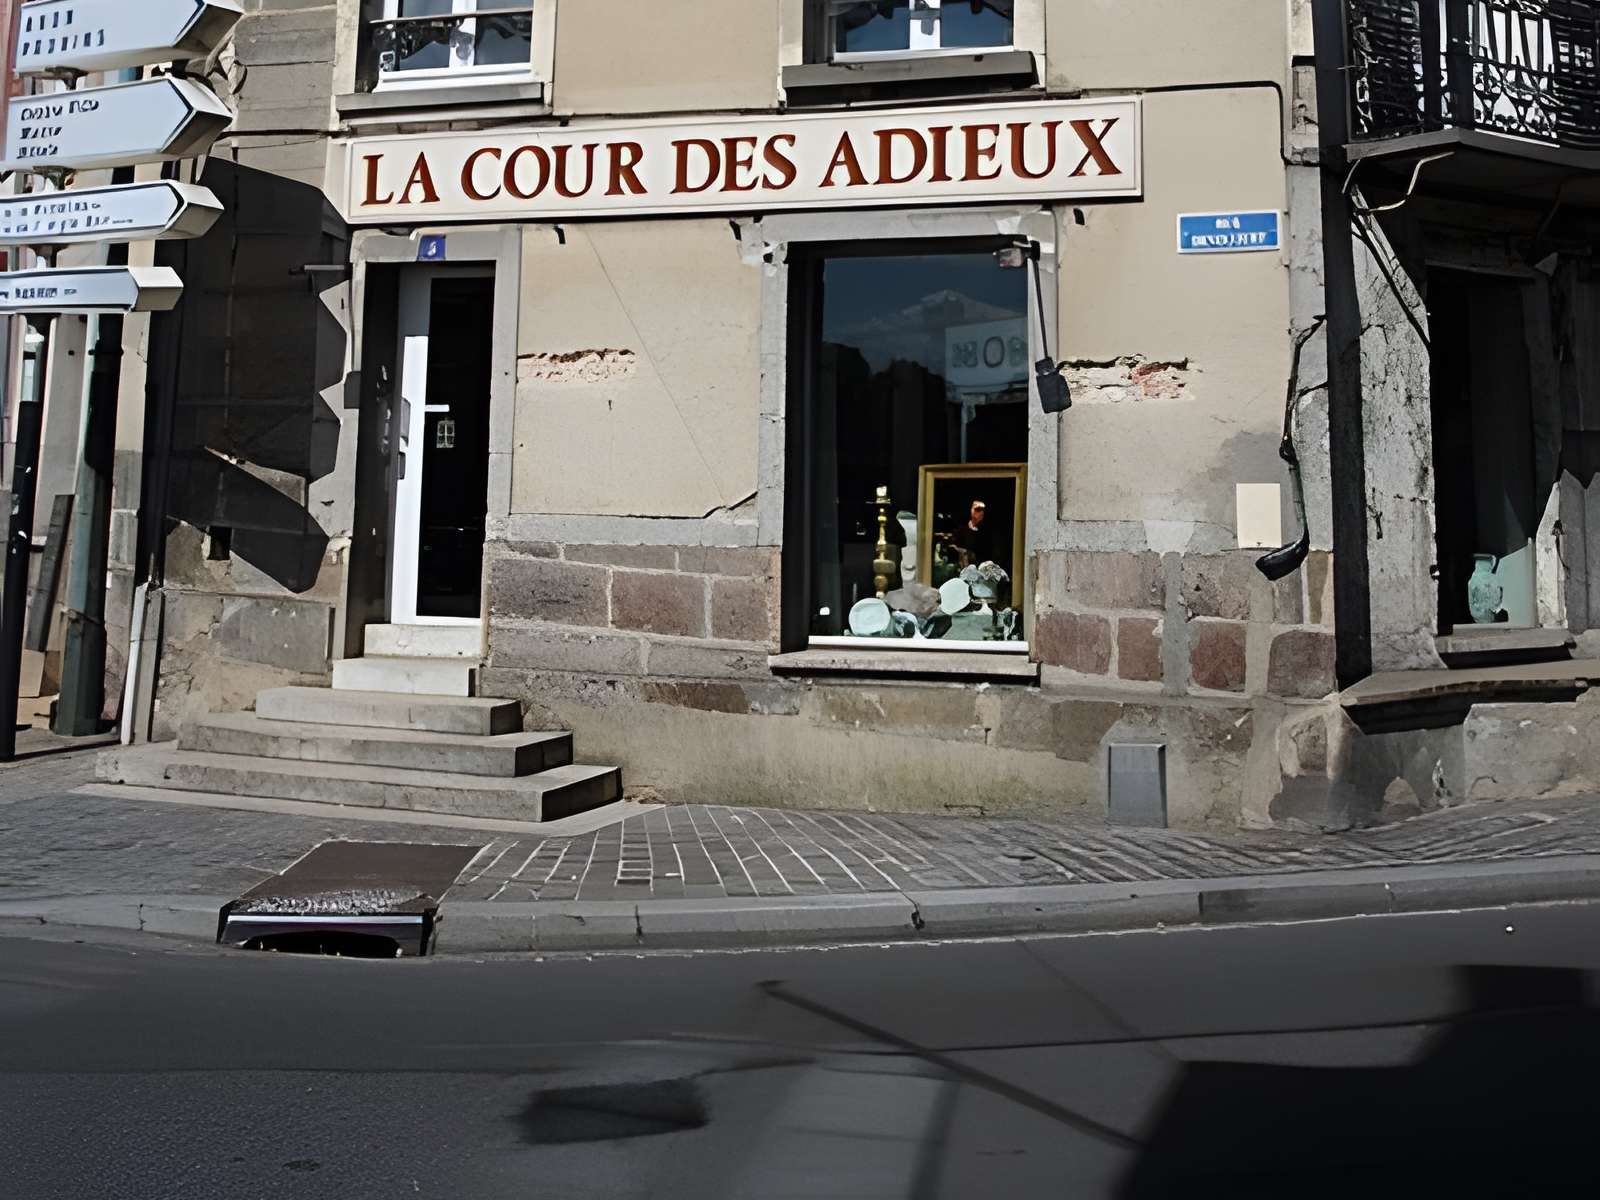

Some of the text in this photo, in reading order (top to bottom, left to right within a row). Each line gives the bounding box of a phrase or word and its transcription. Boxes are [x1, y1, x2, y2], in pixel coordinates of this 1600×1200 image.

[361, 117, 1122, 206] LA COUR DES ADIEUX
